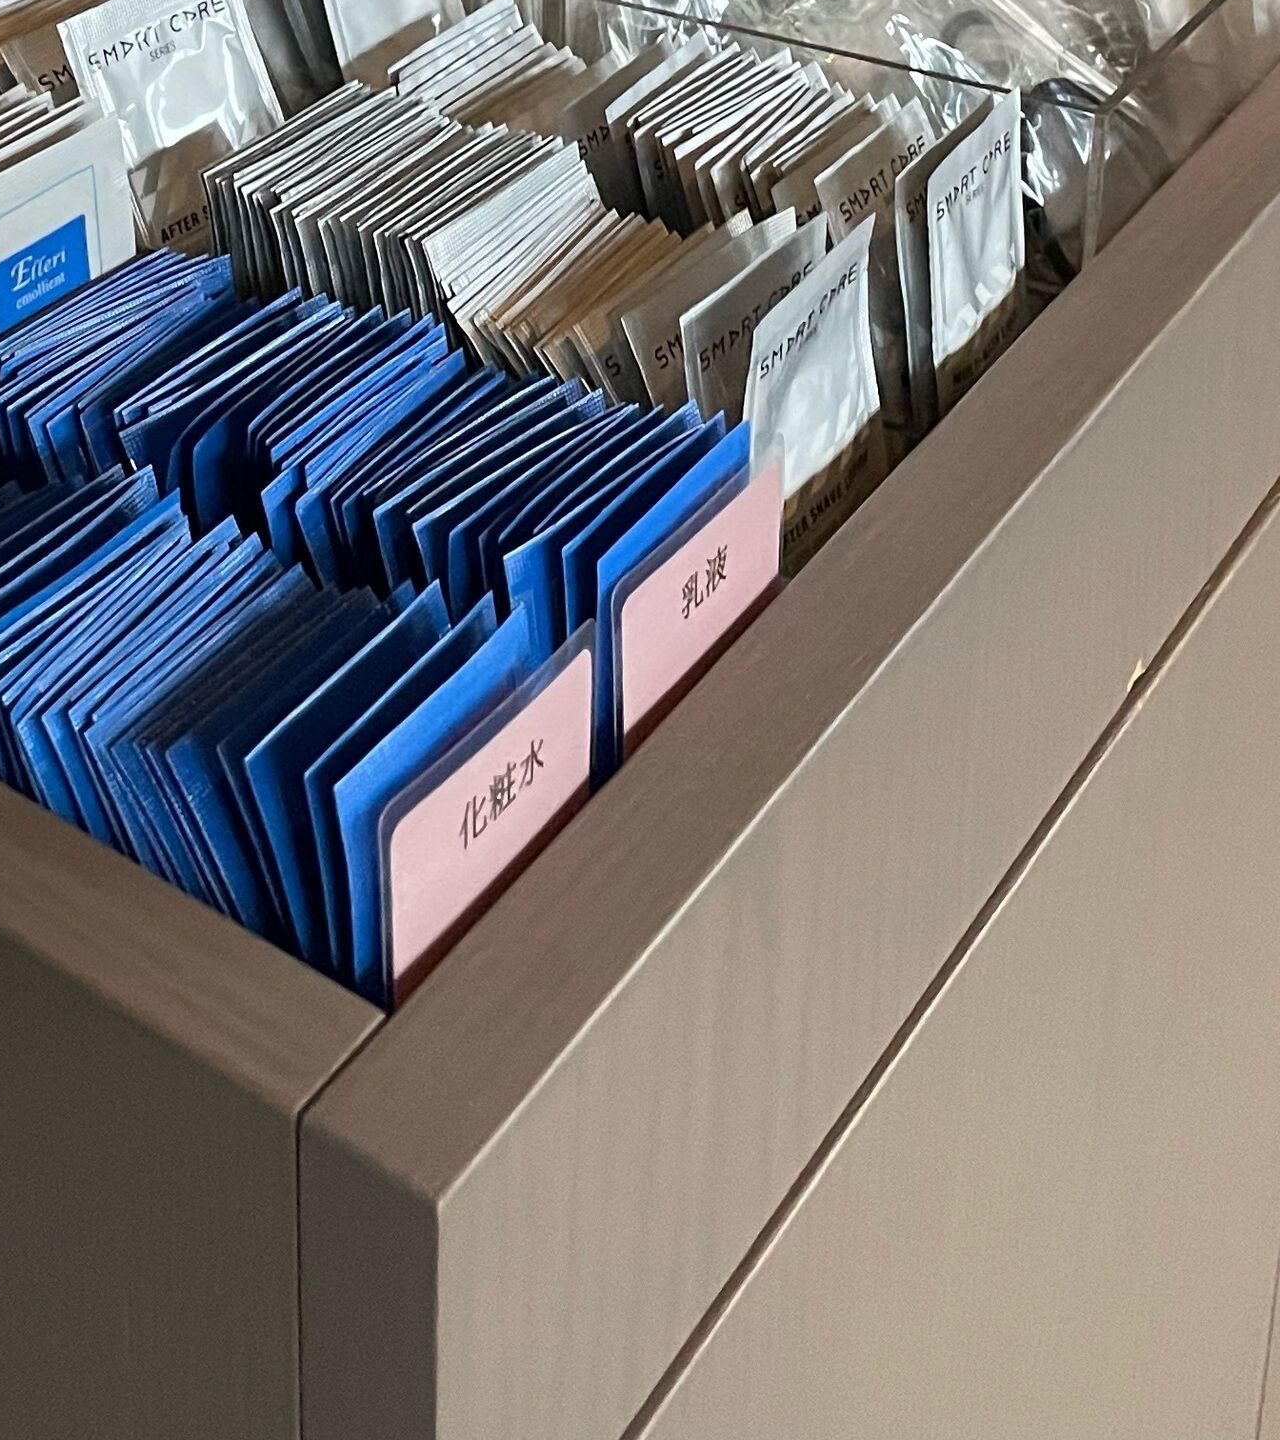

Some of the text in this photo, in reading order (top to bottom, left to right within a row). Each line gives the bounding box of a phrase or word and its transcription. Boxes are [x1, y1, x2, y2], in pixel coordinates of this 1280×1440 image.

[160, 211, 201, 244] AFTER
[10, 244, 67, 292] Elleri
[681, 544, 728, 620] 乳液
[458, 738, 544, 850] 化粧水
